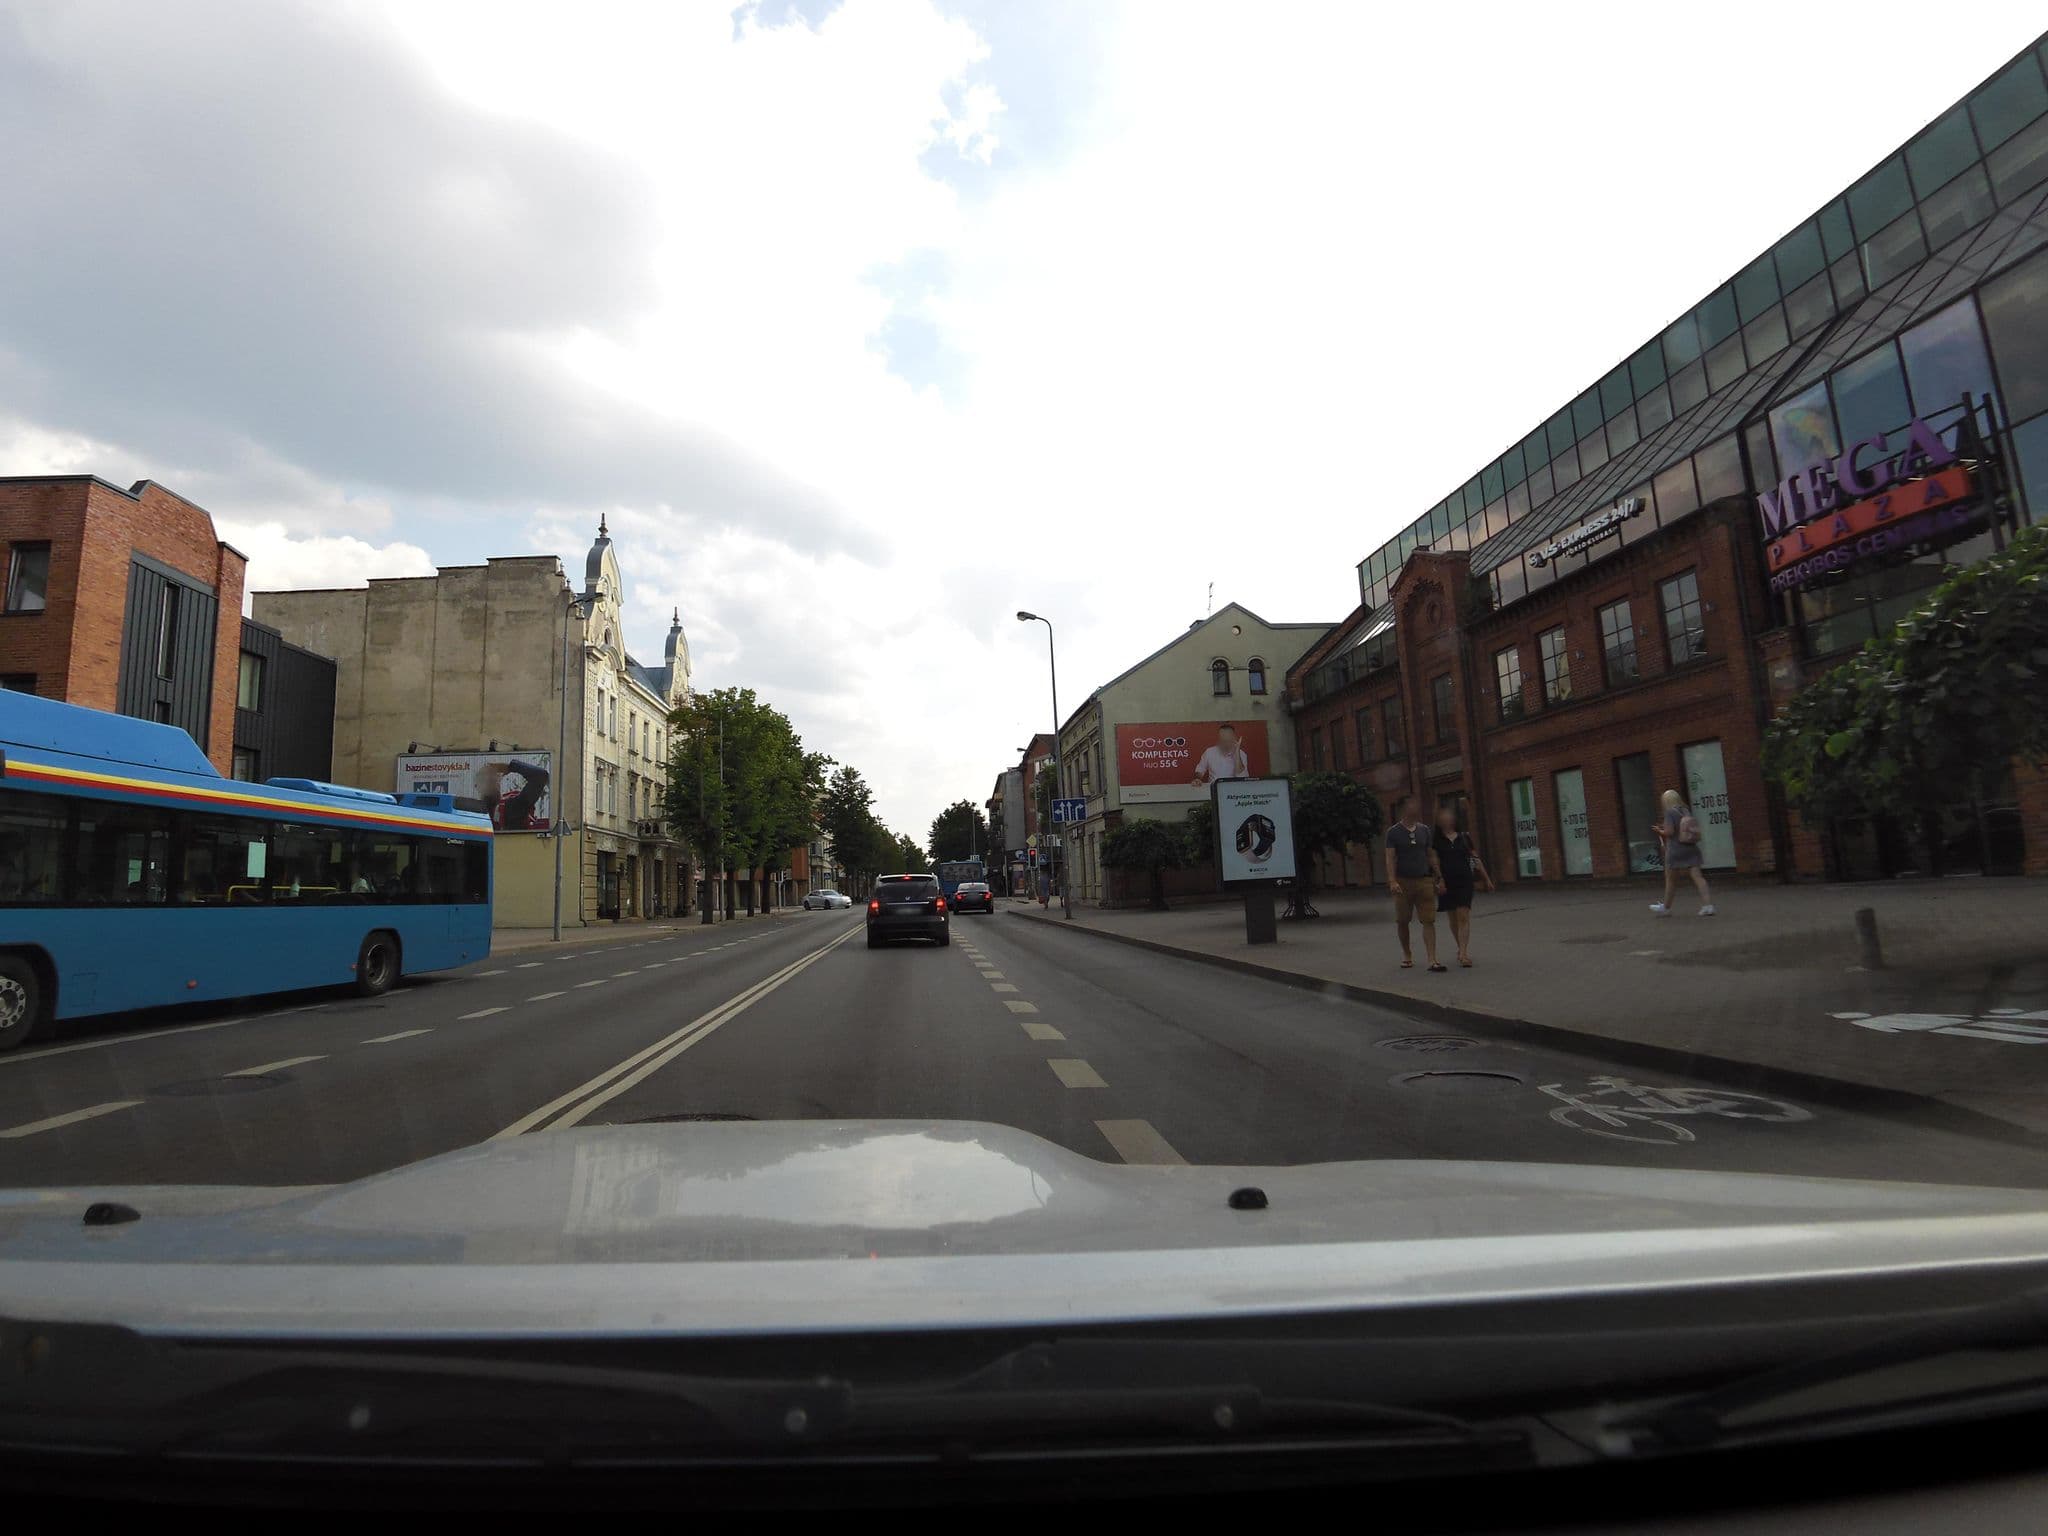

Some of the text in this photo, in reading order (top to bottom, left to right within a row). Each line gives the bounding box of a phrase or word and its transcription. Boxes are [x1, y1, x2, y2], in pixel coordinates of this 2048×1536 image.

[1757, 417, 1957, 540] MEGA
[1770, 478, 1949, 566] PLAZA
[1770, 504, 1969, 594] PREKYBOS CENS
[1131, 749, 1189, 759] KOMPLEKTAS
[1160, 759, 1178, 768] 55€
